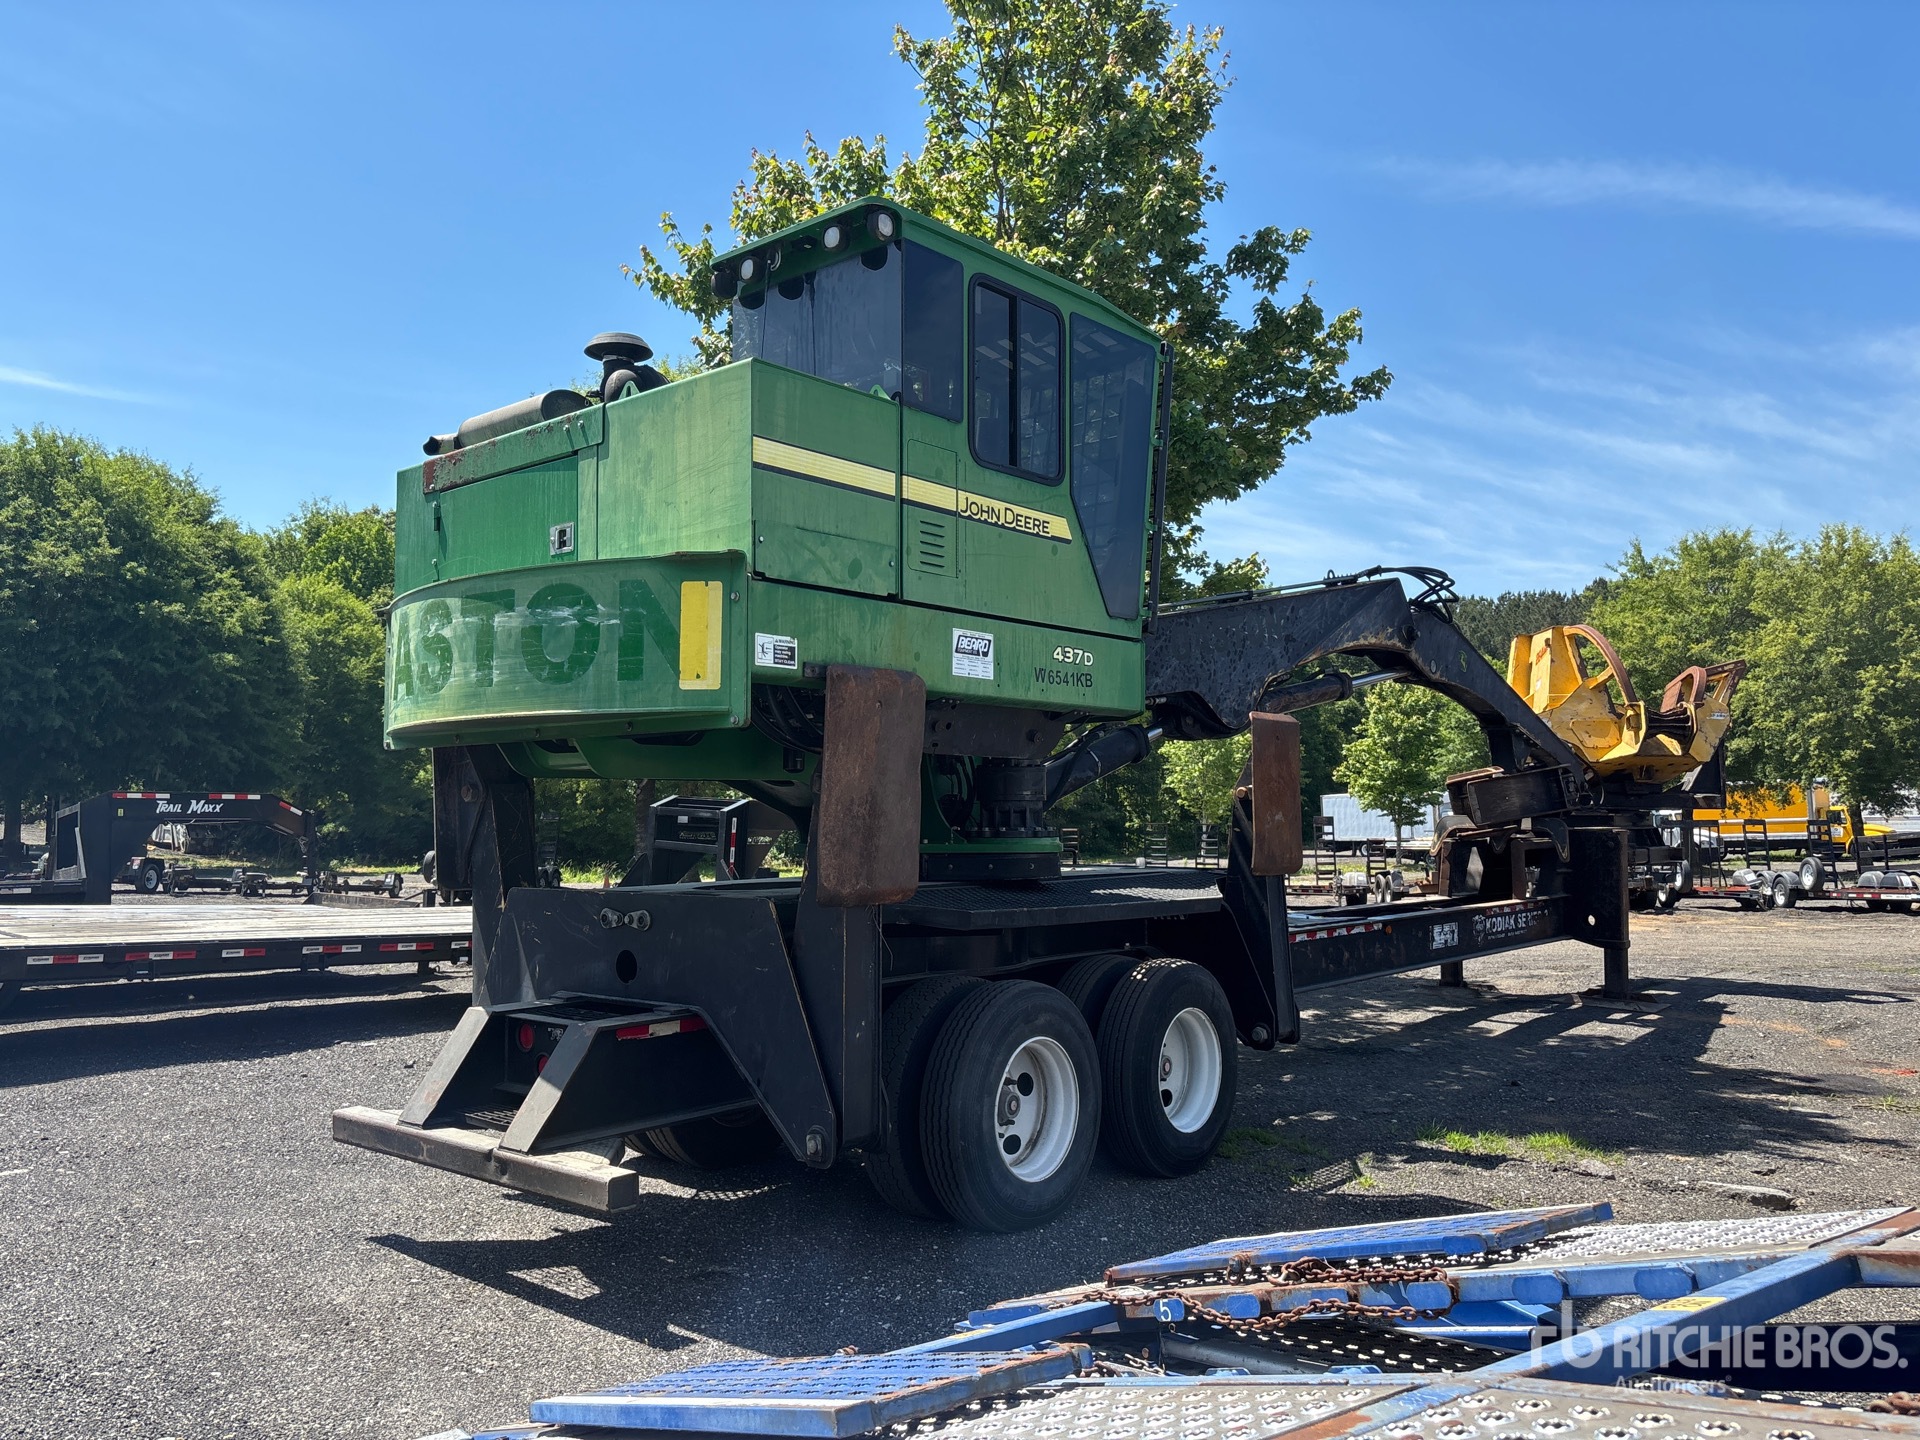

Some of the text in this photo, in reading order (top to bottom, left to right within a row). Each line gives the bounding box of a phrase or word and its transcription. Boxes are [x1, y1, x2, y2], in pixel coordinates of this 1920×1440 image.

[960, 496, 1050, 534] JOHN DEERE
[957, 636, 989, 655] BEARD
[1053, 646, 1094, 666] 437D
[156, 799, 224, 814] TRAIL MAXX
[1485, 914, 1516, 934] KODIAK
[1160, 1298, 1171, 1322] 5
